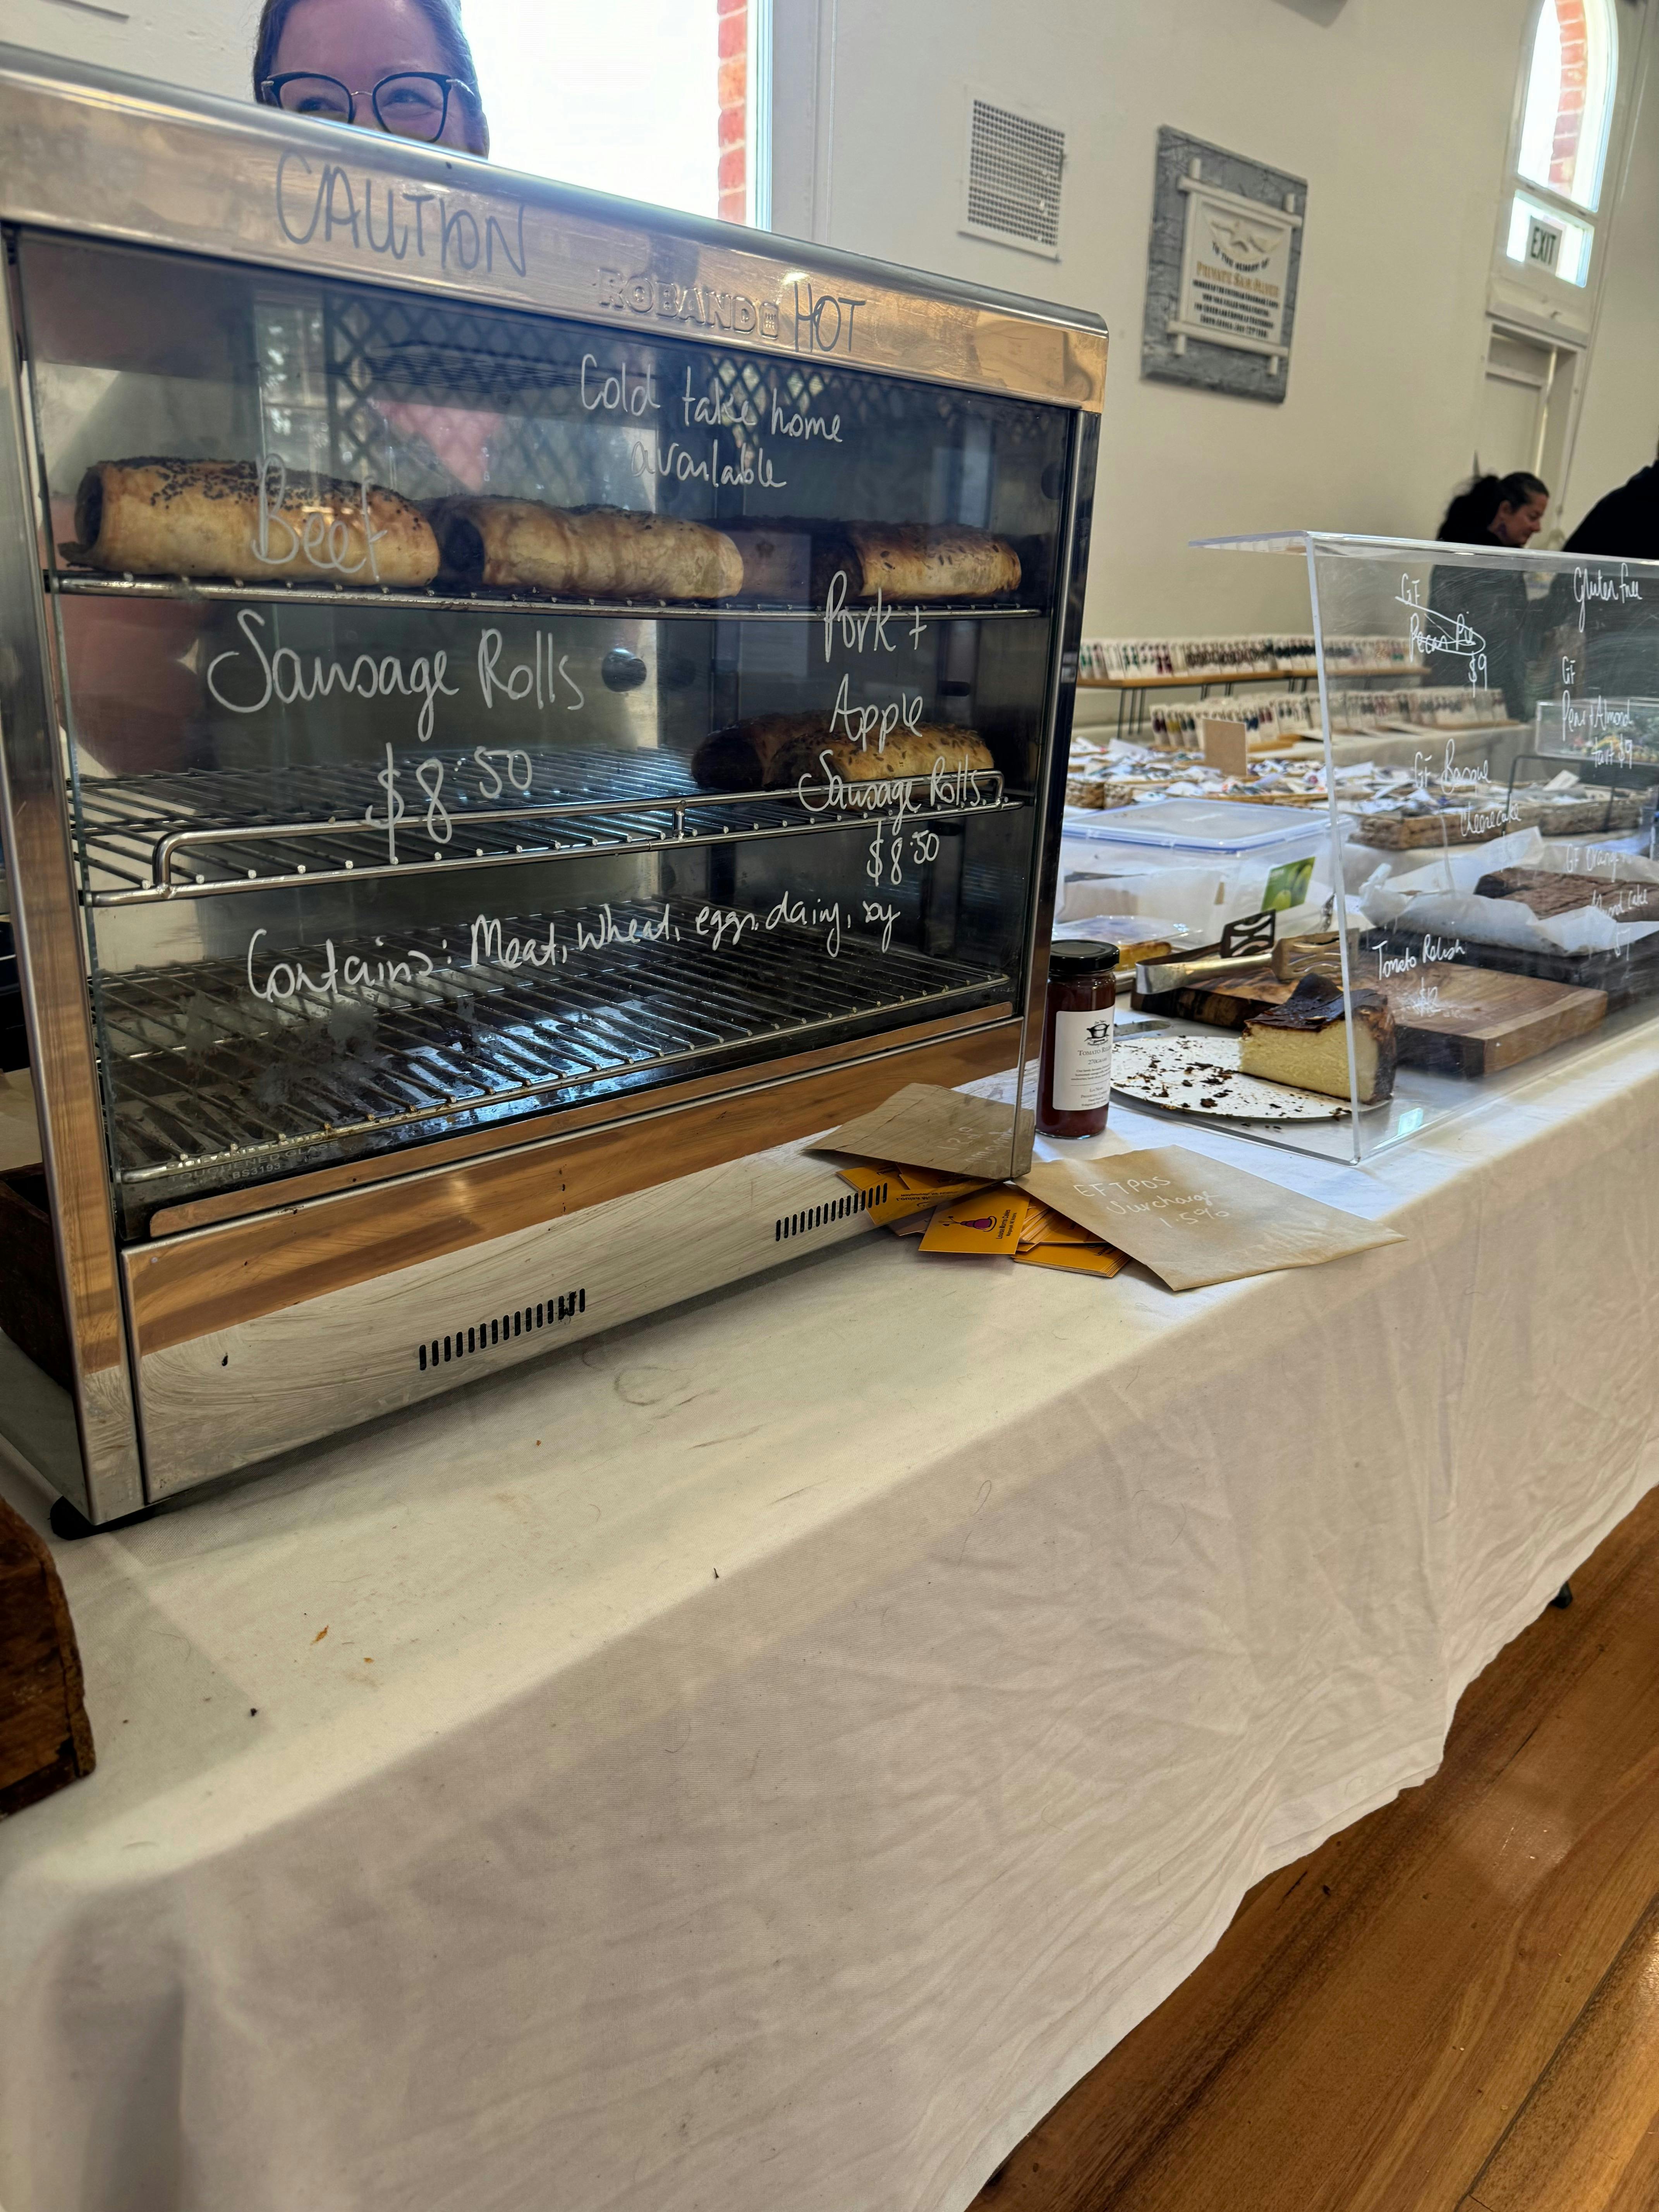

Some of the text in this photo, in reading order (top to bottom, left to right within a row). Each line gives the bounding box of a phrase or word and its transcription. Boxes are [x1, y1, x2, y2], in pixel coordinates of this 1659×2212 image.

[276, 150, 866, 353] CAUTION HOT
[1530, 226, 1557, 265] EXIT
[581, 353, 843, 443] Cold take home
[631, 439, 787, 488] available
[252, 453, 388, 582] Beef
[824, 570, 927, 663] Pork +
[1573, 567, 1618, 633] Gluten
[207, 608, 585, 742] Sausage Rolls
[830, 673, 923, 754] Apple
[1594, 695, 1634, 731] Almond
[798, 749, 922, 836] Sausage
[232, 1162, 281, 1179] BS3193
[285, 1140, 340, 1158] GLASS
[1073, 1176, 1171, 1197] EFTPOS
[1106, 1189, 1220, 1216] Surcharge
